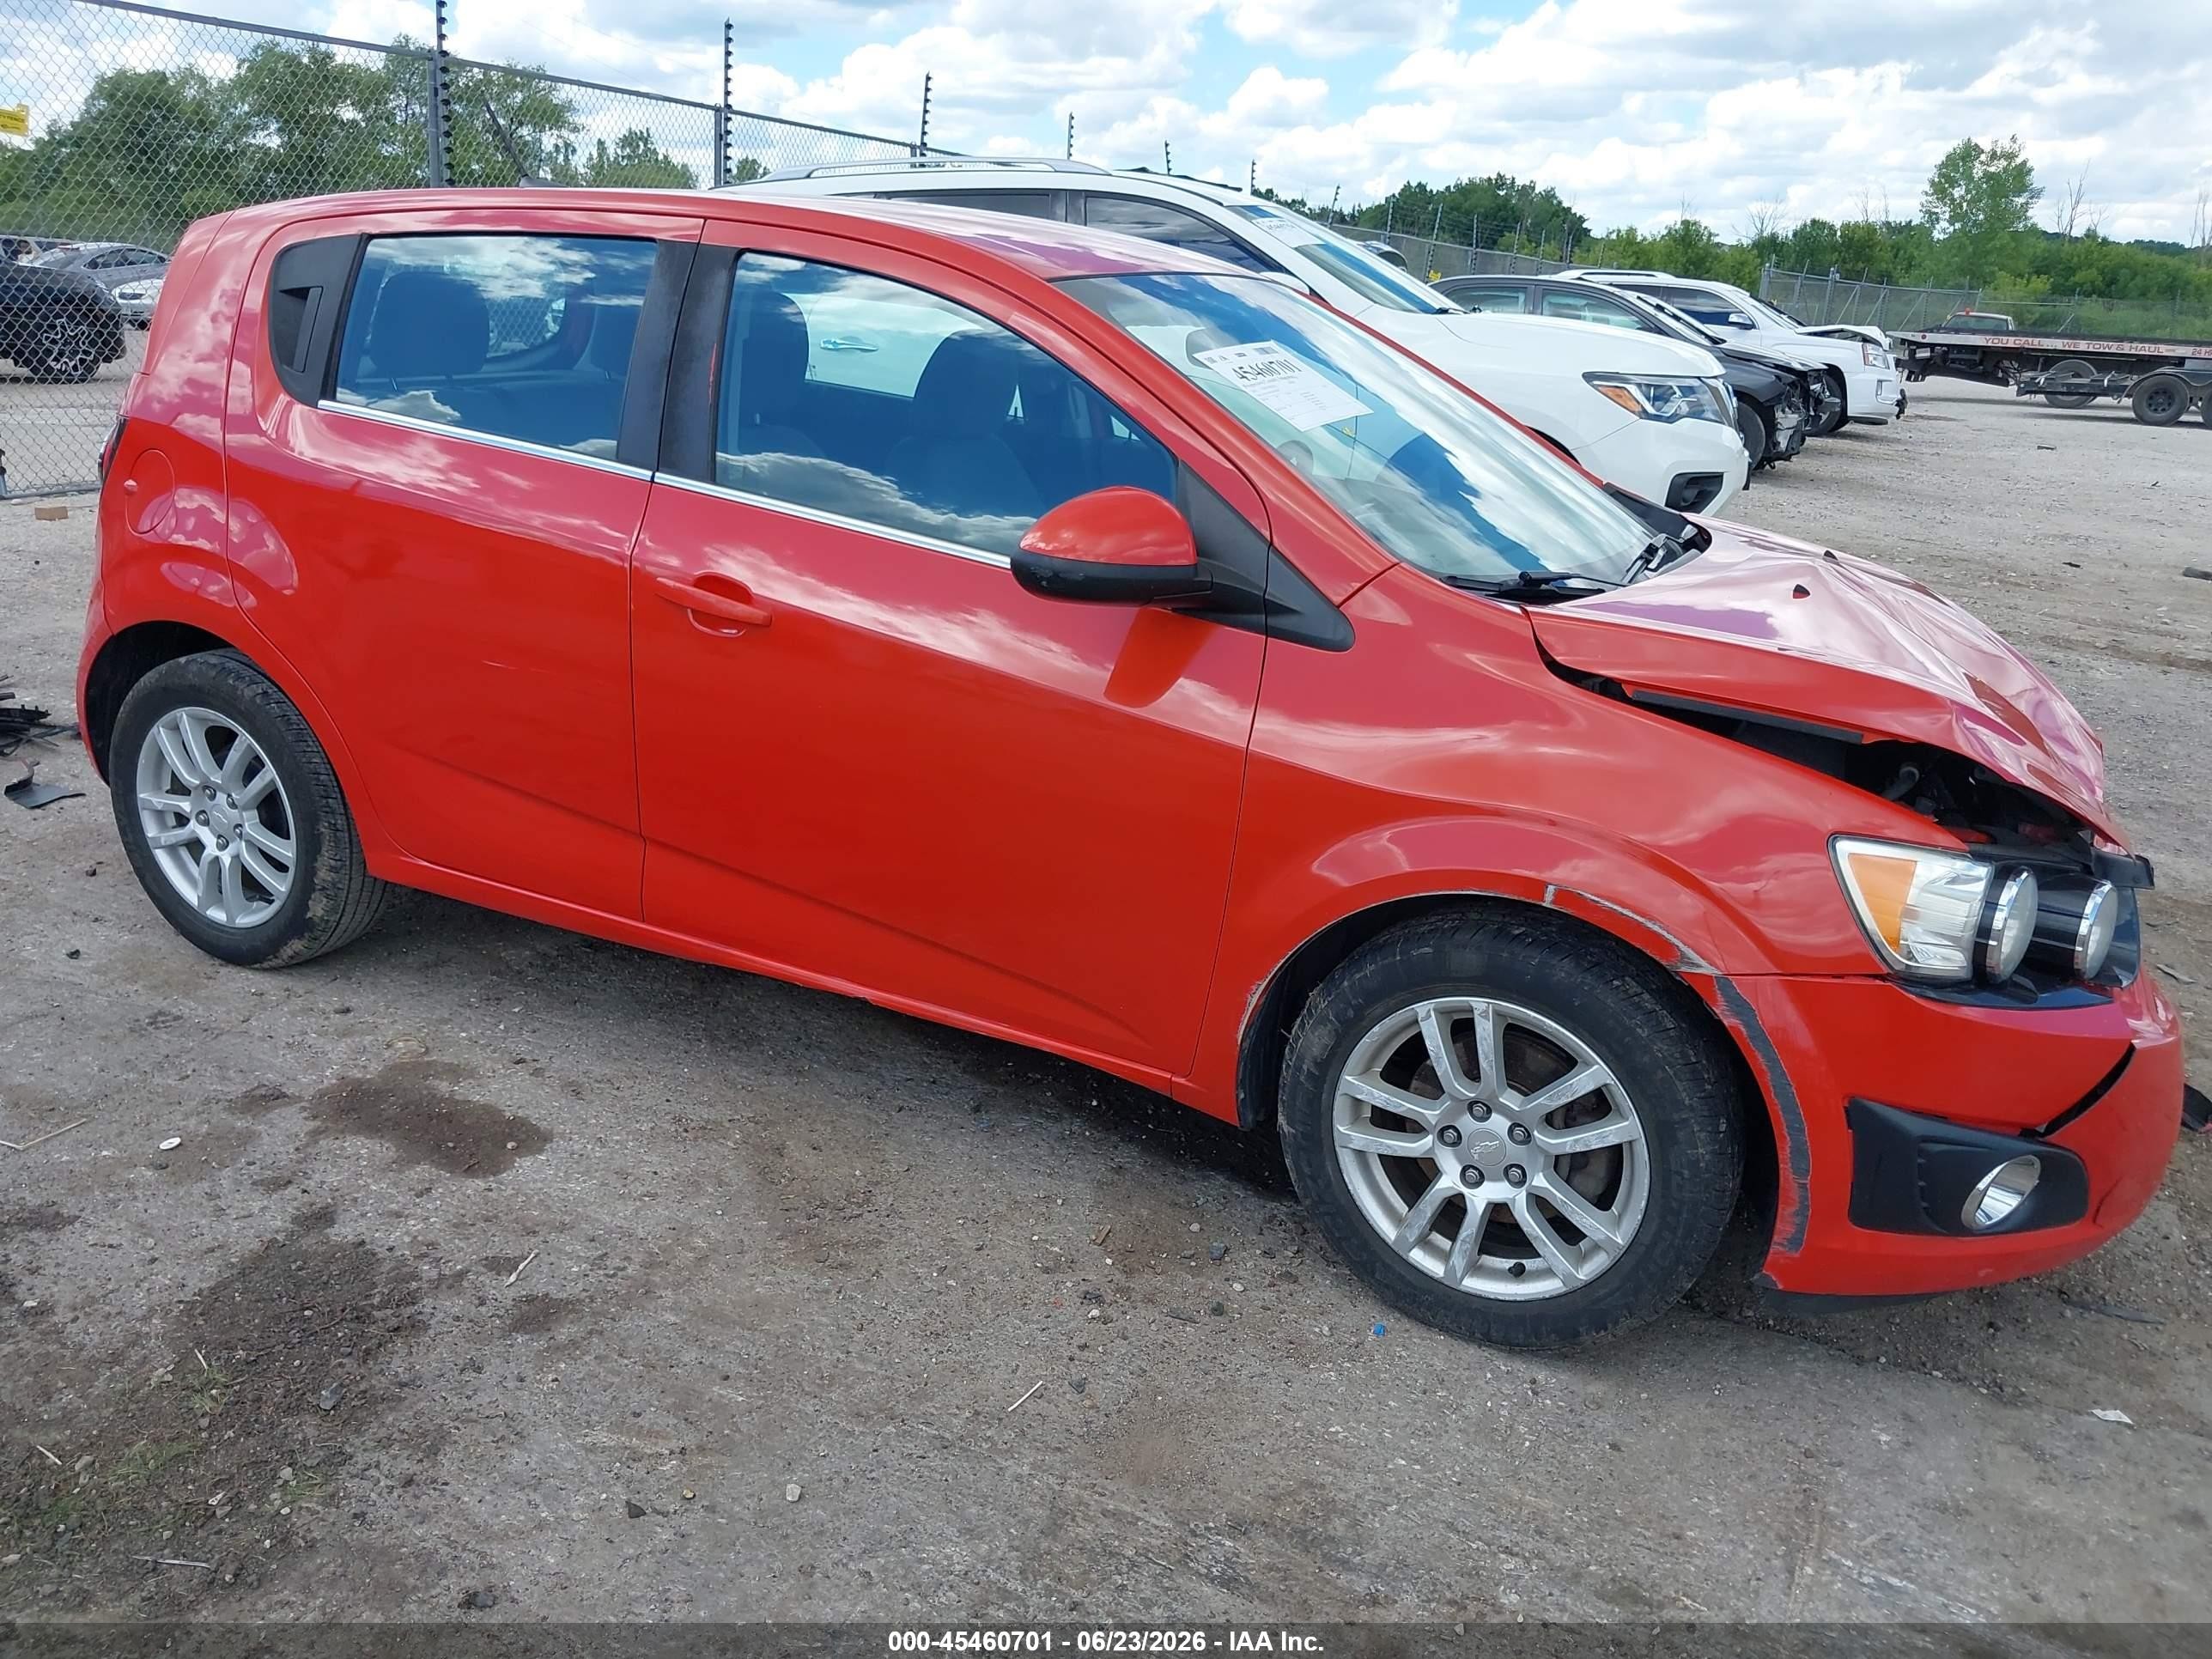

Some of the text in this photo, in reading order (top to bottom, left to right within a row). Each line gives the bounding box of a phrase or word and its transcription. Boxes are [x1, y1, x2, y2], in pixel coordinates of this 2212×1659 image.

[2087, 343, 2113, 351] TOW
[2130, 345, 2164, 354] HAUL
[2191, 348, 2202, 356] 24
[1231, 359, 1303, 381] 45460701
